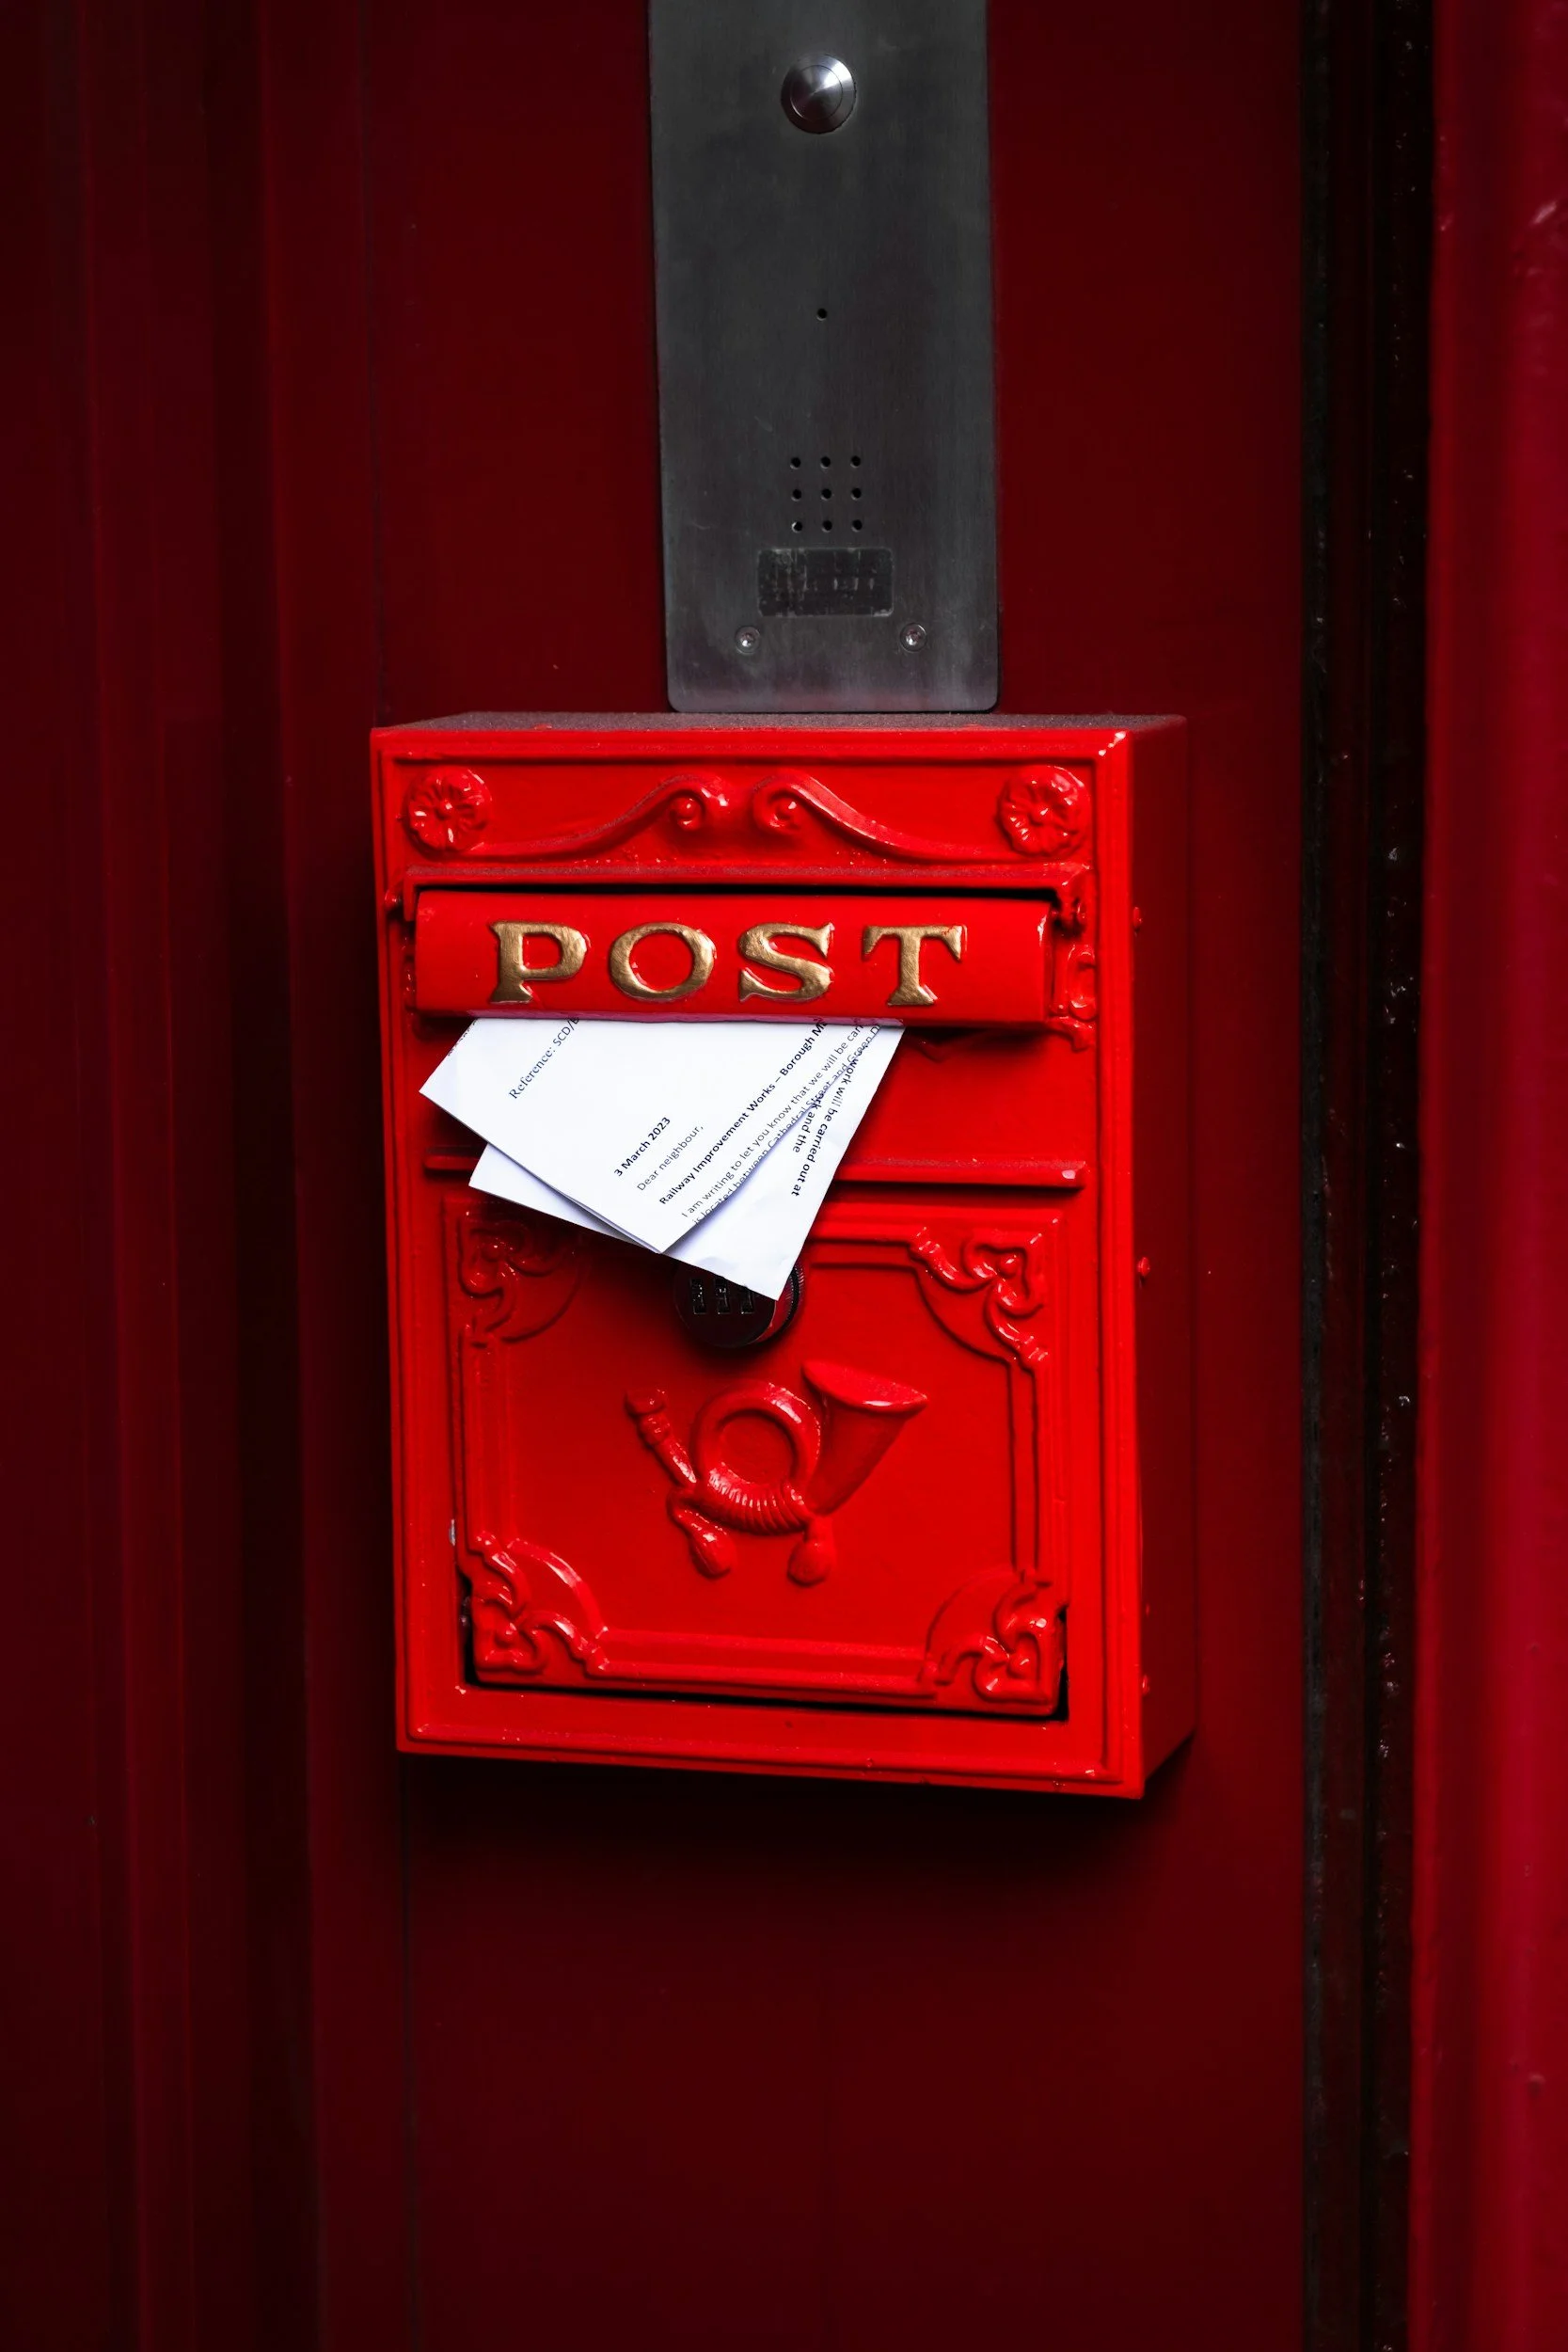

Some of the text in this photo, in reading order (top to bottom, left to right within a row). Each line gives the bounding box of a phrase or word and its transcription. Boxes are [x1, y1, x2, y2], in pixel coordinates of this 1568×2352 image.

[488, 921, 966, 1006] POST
[509, 1046, 556, 1099] Reference:
[805, 1081, 832, 1105] Street
[832, 1063, 848, 1081] and
[847, 1036, 873, 1063] Green
[613, 1117, 671, 1177] 3 March 2023
[658, 1172, 696, 1204] Railway
[692, 1112, 750, 1172] Improvement
[746, 1083, 776, 1112] Works
[779, 1036, 816, 1076] Borough
[688, 1200, 704, 1214] am
[702, 1171, 735, 1200] writing
[730, 1160, 742, 1171] to
[739, 1146, 754, 1159] let
[752, 1129, 770, 1147] you
[767, 1104, 792, 1129] know
[790, 1086, 810, 1104] that
[808, 1072, 823, 1086] we
[821, 1054, 838, 1072] will
[833, 1041, 848, 1055] be
[791, 1058, 859, 1197] work will be carried out at
[792, 1134, 807, 1153] the
[800, 1111, 816, 1133] and
[637, 1126, 704, 1191] Dear neighbour,
